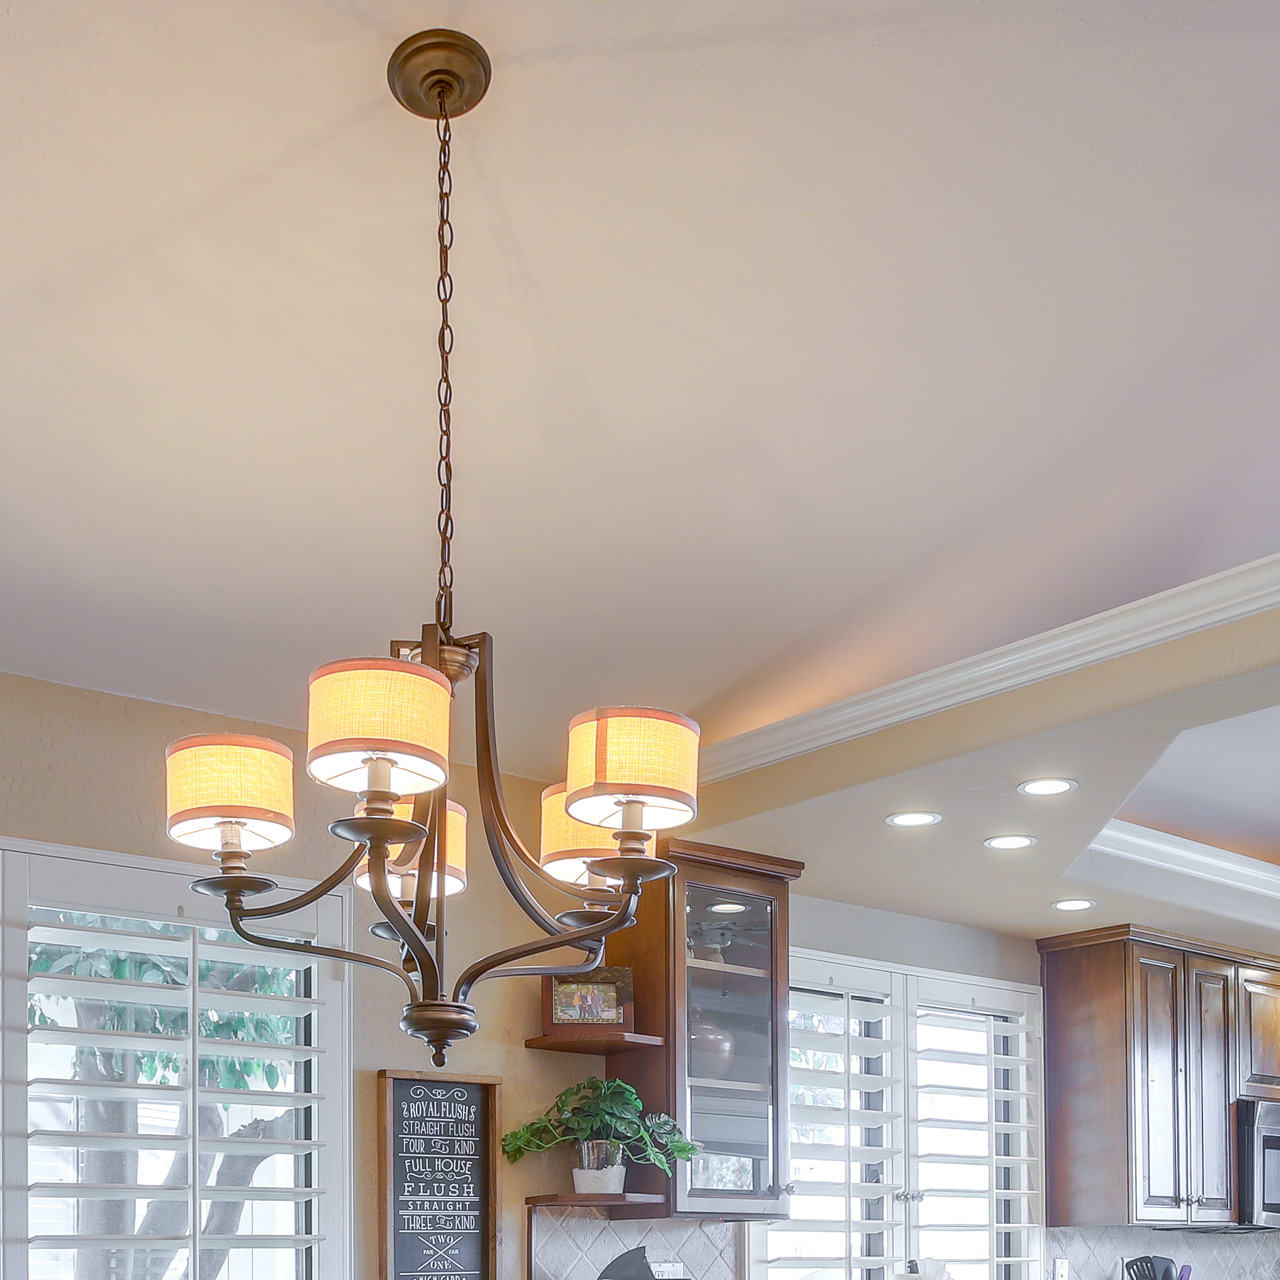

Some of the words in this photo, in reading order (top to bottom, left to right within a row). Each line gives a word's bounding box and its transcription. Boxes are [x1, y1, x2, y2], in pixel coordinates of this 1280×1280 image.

[410, 1101, 440, 1118] ROYAL
[441, 1102, 468, 1121] FLUSH
[402, 1120, 446, 1135] STRAIGHT
[449, 1122, 475, 1136] FLUSH
[403, 1138, 425, 1153] FOUR
[454, 1140, 475, 1154] KIND
[405, 1158, 432, 1173] FULL
[435, 1158, 473, 1174] HOUSE
[403, 1182, 475, 1196] FLUSH
[408, 1201, 471, 1211] STRAIGHT
[402, 1215, 433, 1230] THREE
[455, 1215, 476, 1230] KIND
[429, 1234, 454, 1245] TWO
[430, 1260, 452, 1270] ONE
